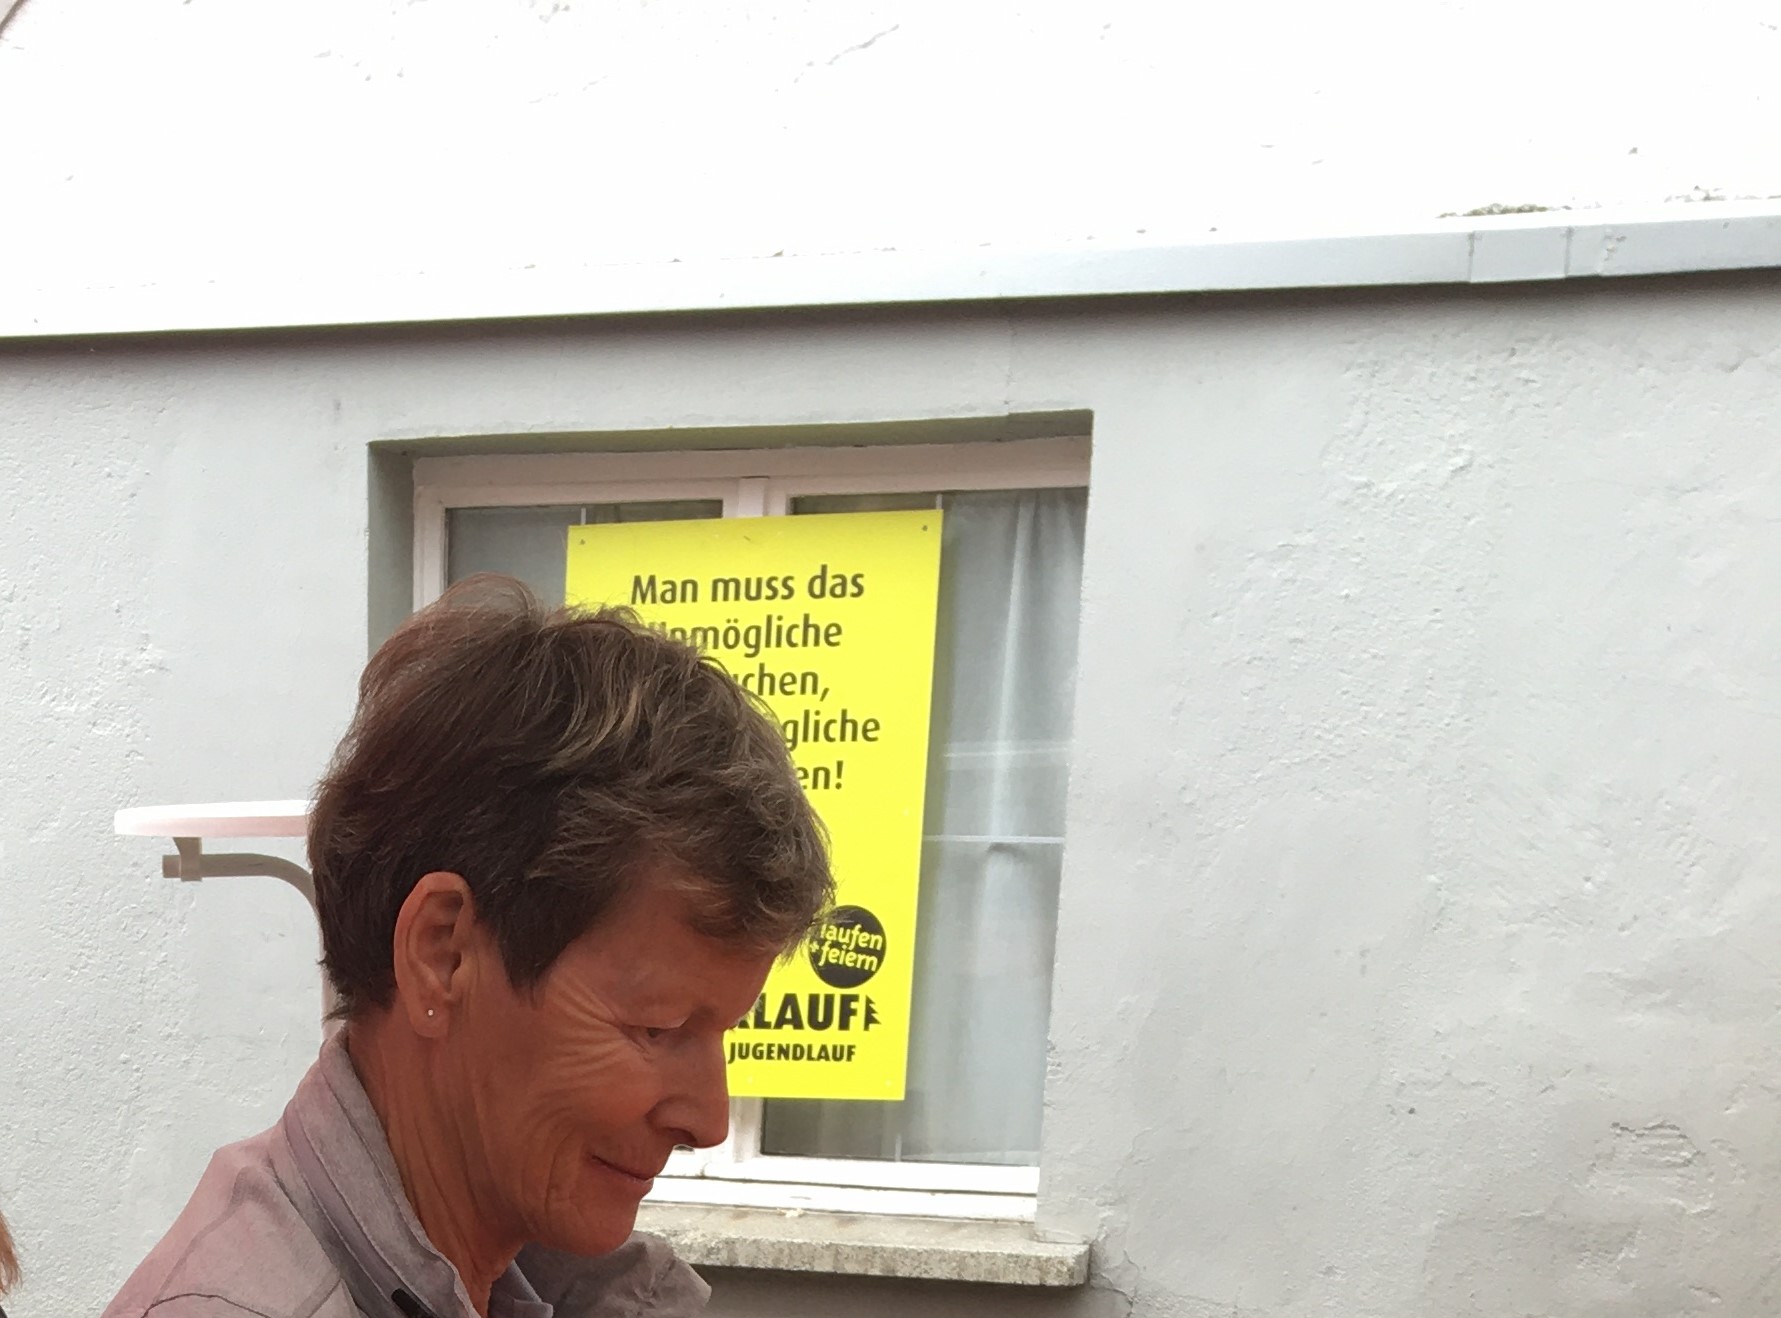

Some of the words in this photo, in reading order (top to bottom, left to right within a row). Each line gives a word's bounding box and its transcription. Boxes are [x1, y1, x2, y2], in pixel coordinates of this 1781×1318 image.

[631, 574, 698, 605] Man
[711, 574, 795, 602] muss
[807, 563, 865, 599] das
[733, 662, 830, 702] chen,
[782, 708, 881, 752] gliche
[796, 760, 844, 790] en!
[820, 923, 883, 951] laufen
[737, 992, 860, 1031] LAUF
[728, 1042, 856, 1064] JUGENDLAUF
